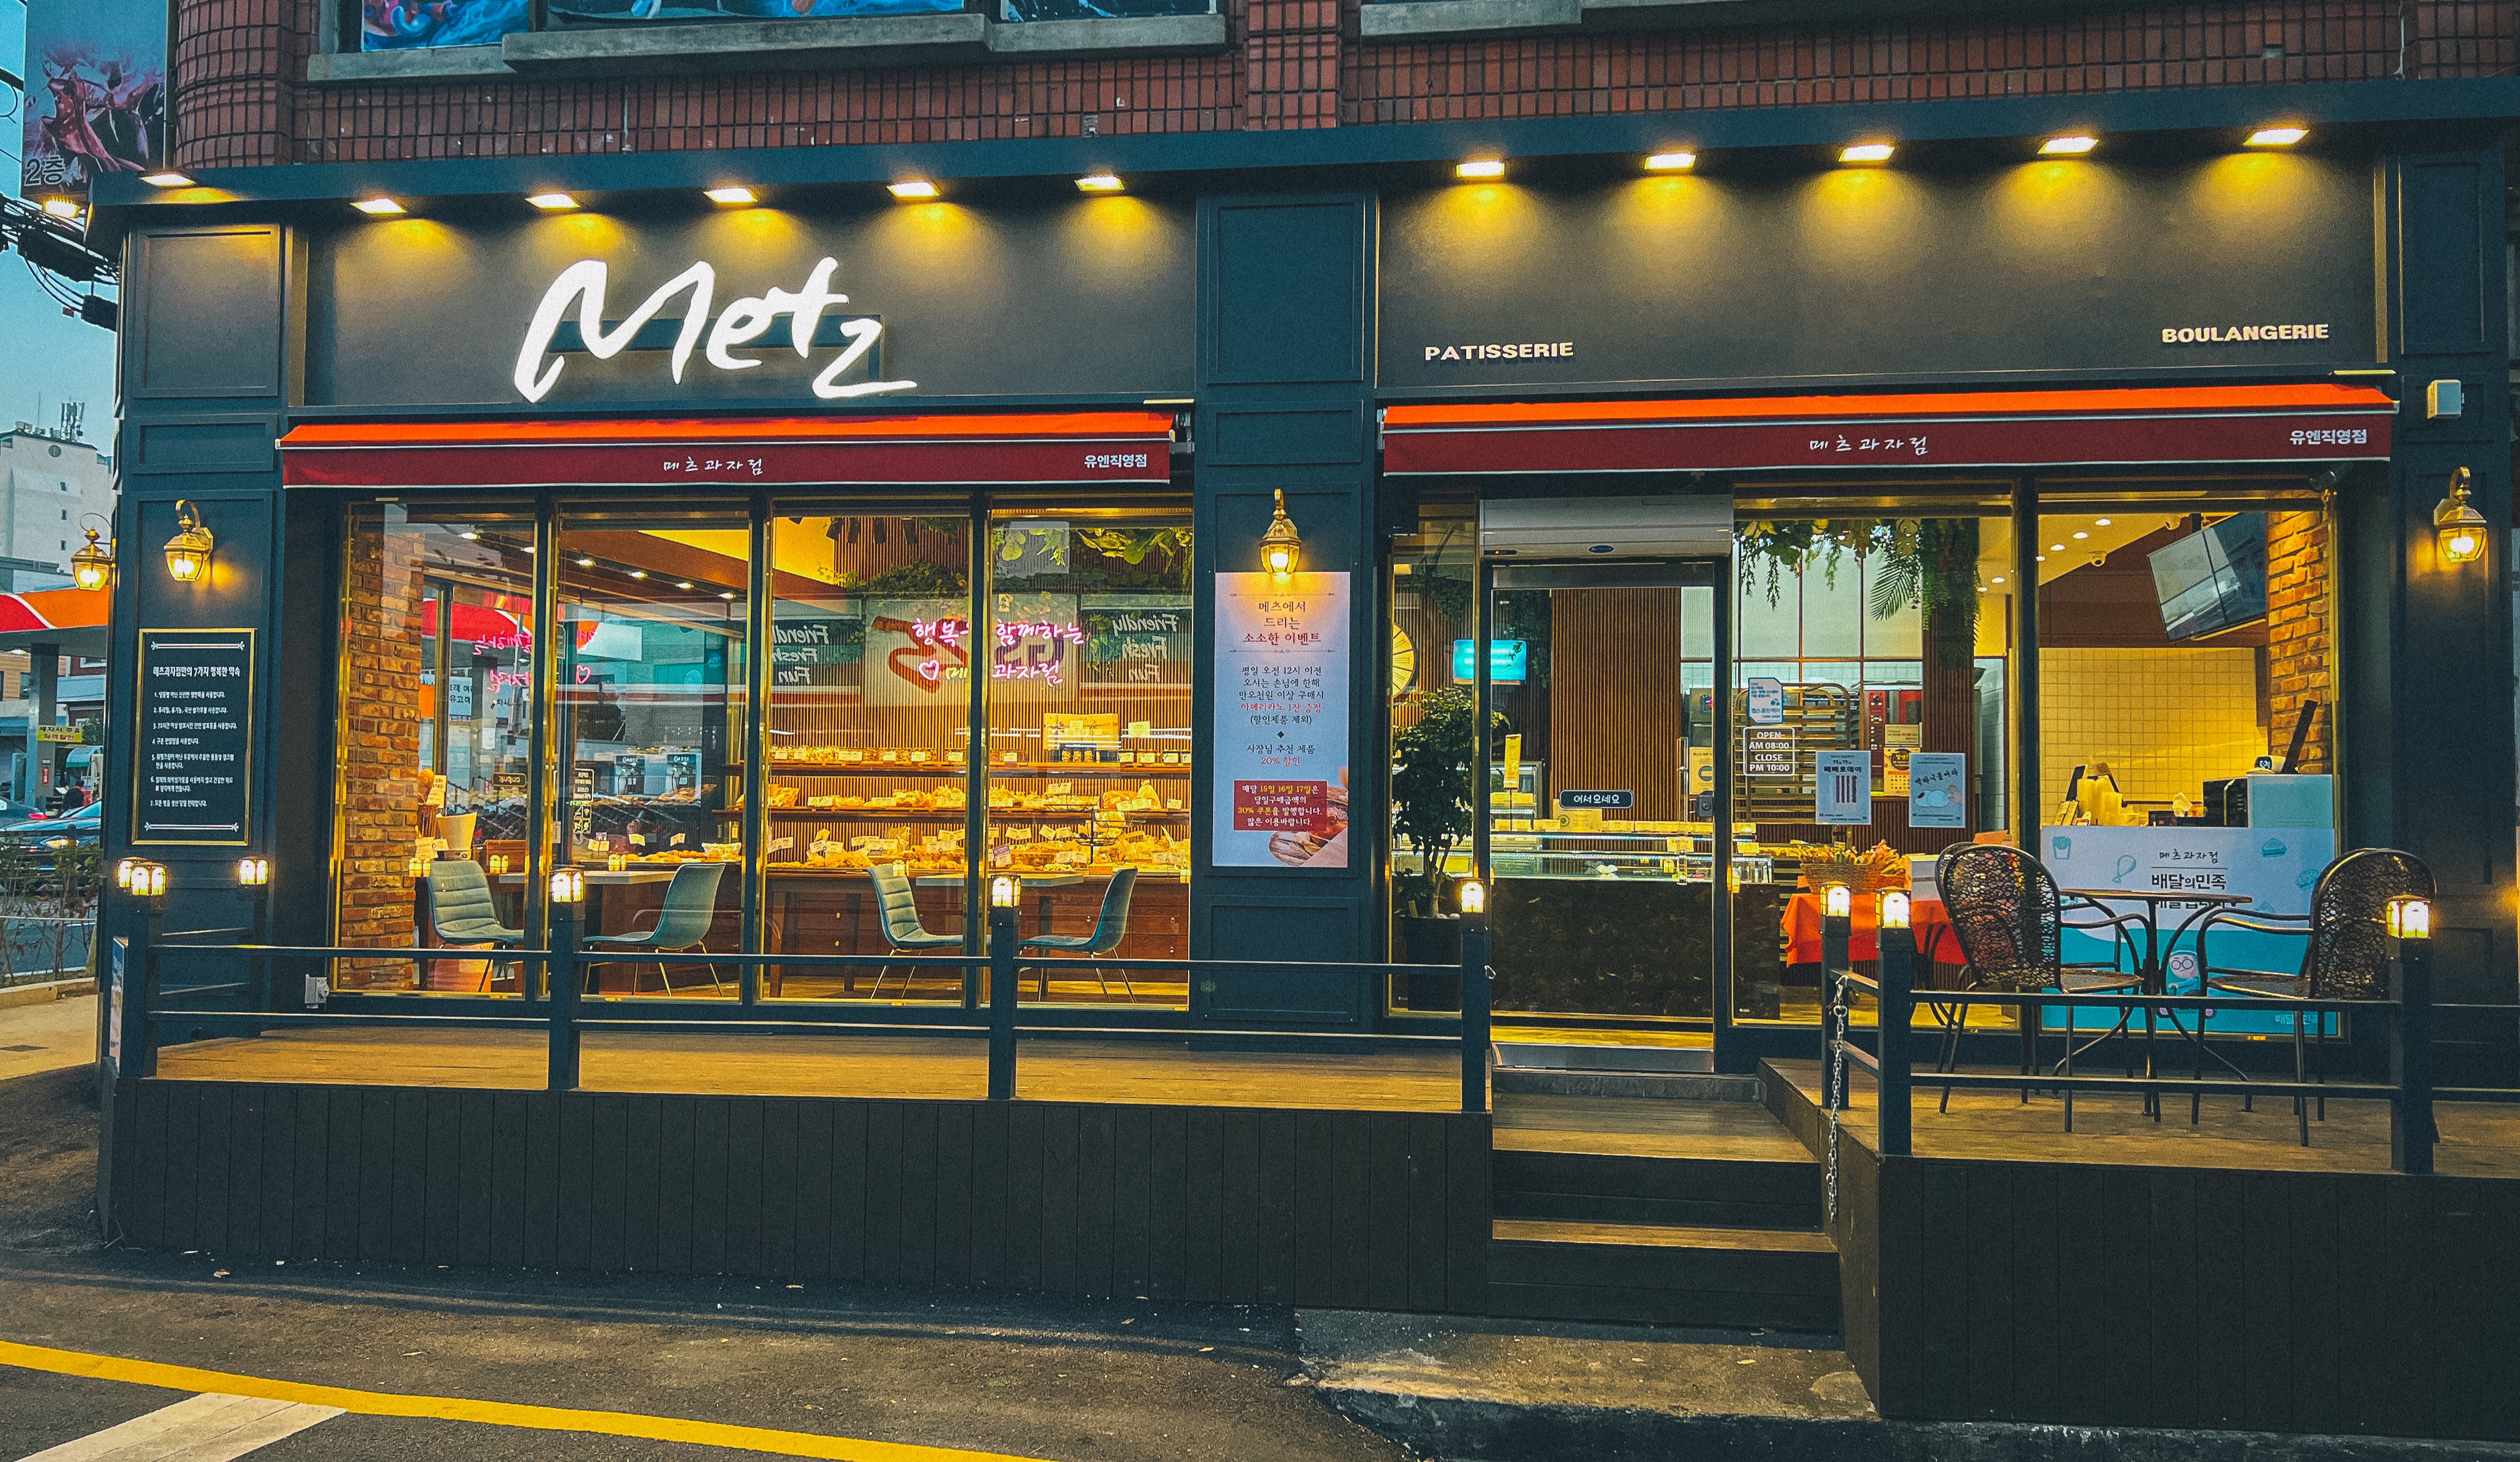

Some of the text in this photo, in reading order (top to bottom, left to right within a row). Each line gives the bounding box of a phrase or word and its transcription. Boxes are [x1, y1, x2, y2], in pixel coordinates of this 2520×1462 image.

[24, 154, 66, 186] 2층
[514, 256, 918, 403] Metz
[2162, 324, 2329, 343] BOULANGERIE
[1425, 341, 1574, 361] PATISSERIE
[2289, 429, 2368, 445] 유엔직영점
[1084, 454, 1148, 469] 유엔직영점
[1258, 600, 1306, 613] 메츠에서
[1263, 617, 1301, 630] 드리는
[996, 619, 1085, 647] 함께하는
[1242, 632, 1321, 646] 소소한 이벤트
[194, 666, 209, 677] 7가지
[210, 666, 228, 677] 행복한
[228, 666, 241, 677] 약속
[1241, 665, 1322, 677] 평일 오전 12시 이전
[1242, 678, 1320, 689] 오시는 손님에 한해
[1239, 690, 1324, 701] 만오천원 이상 구매시
[1241, 702, 1322, 714] 아메리카노 1잔 증정
[1250, 715, 1312, 725] (할인제품 제외)
[1246, 744, 1316, 755] 사장님 추천 제품
[1261, 756, 1301, 767] 20% 할인
[1755, 753, 1783, 762] CLOSE
[1766, 763, 1790, 772] 10:00
[1242, 785, 1319, 794] 매달 15일 16일 17일은
[1254, 795, 1307, 805] 당일구매금액의
[1573, 793, 1620, 804] 어서오세요
[1256, 807, 1280, 816] 쿠폰을
[1282, 807, 1322, 816] 발행합니다.
[1247, 817, 1312, 827] 많은 이용바랍니다.
[2151, 873, 2227, 890] 배달의민족
